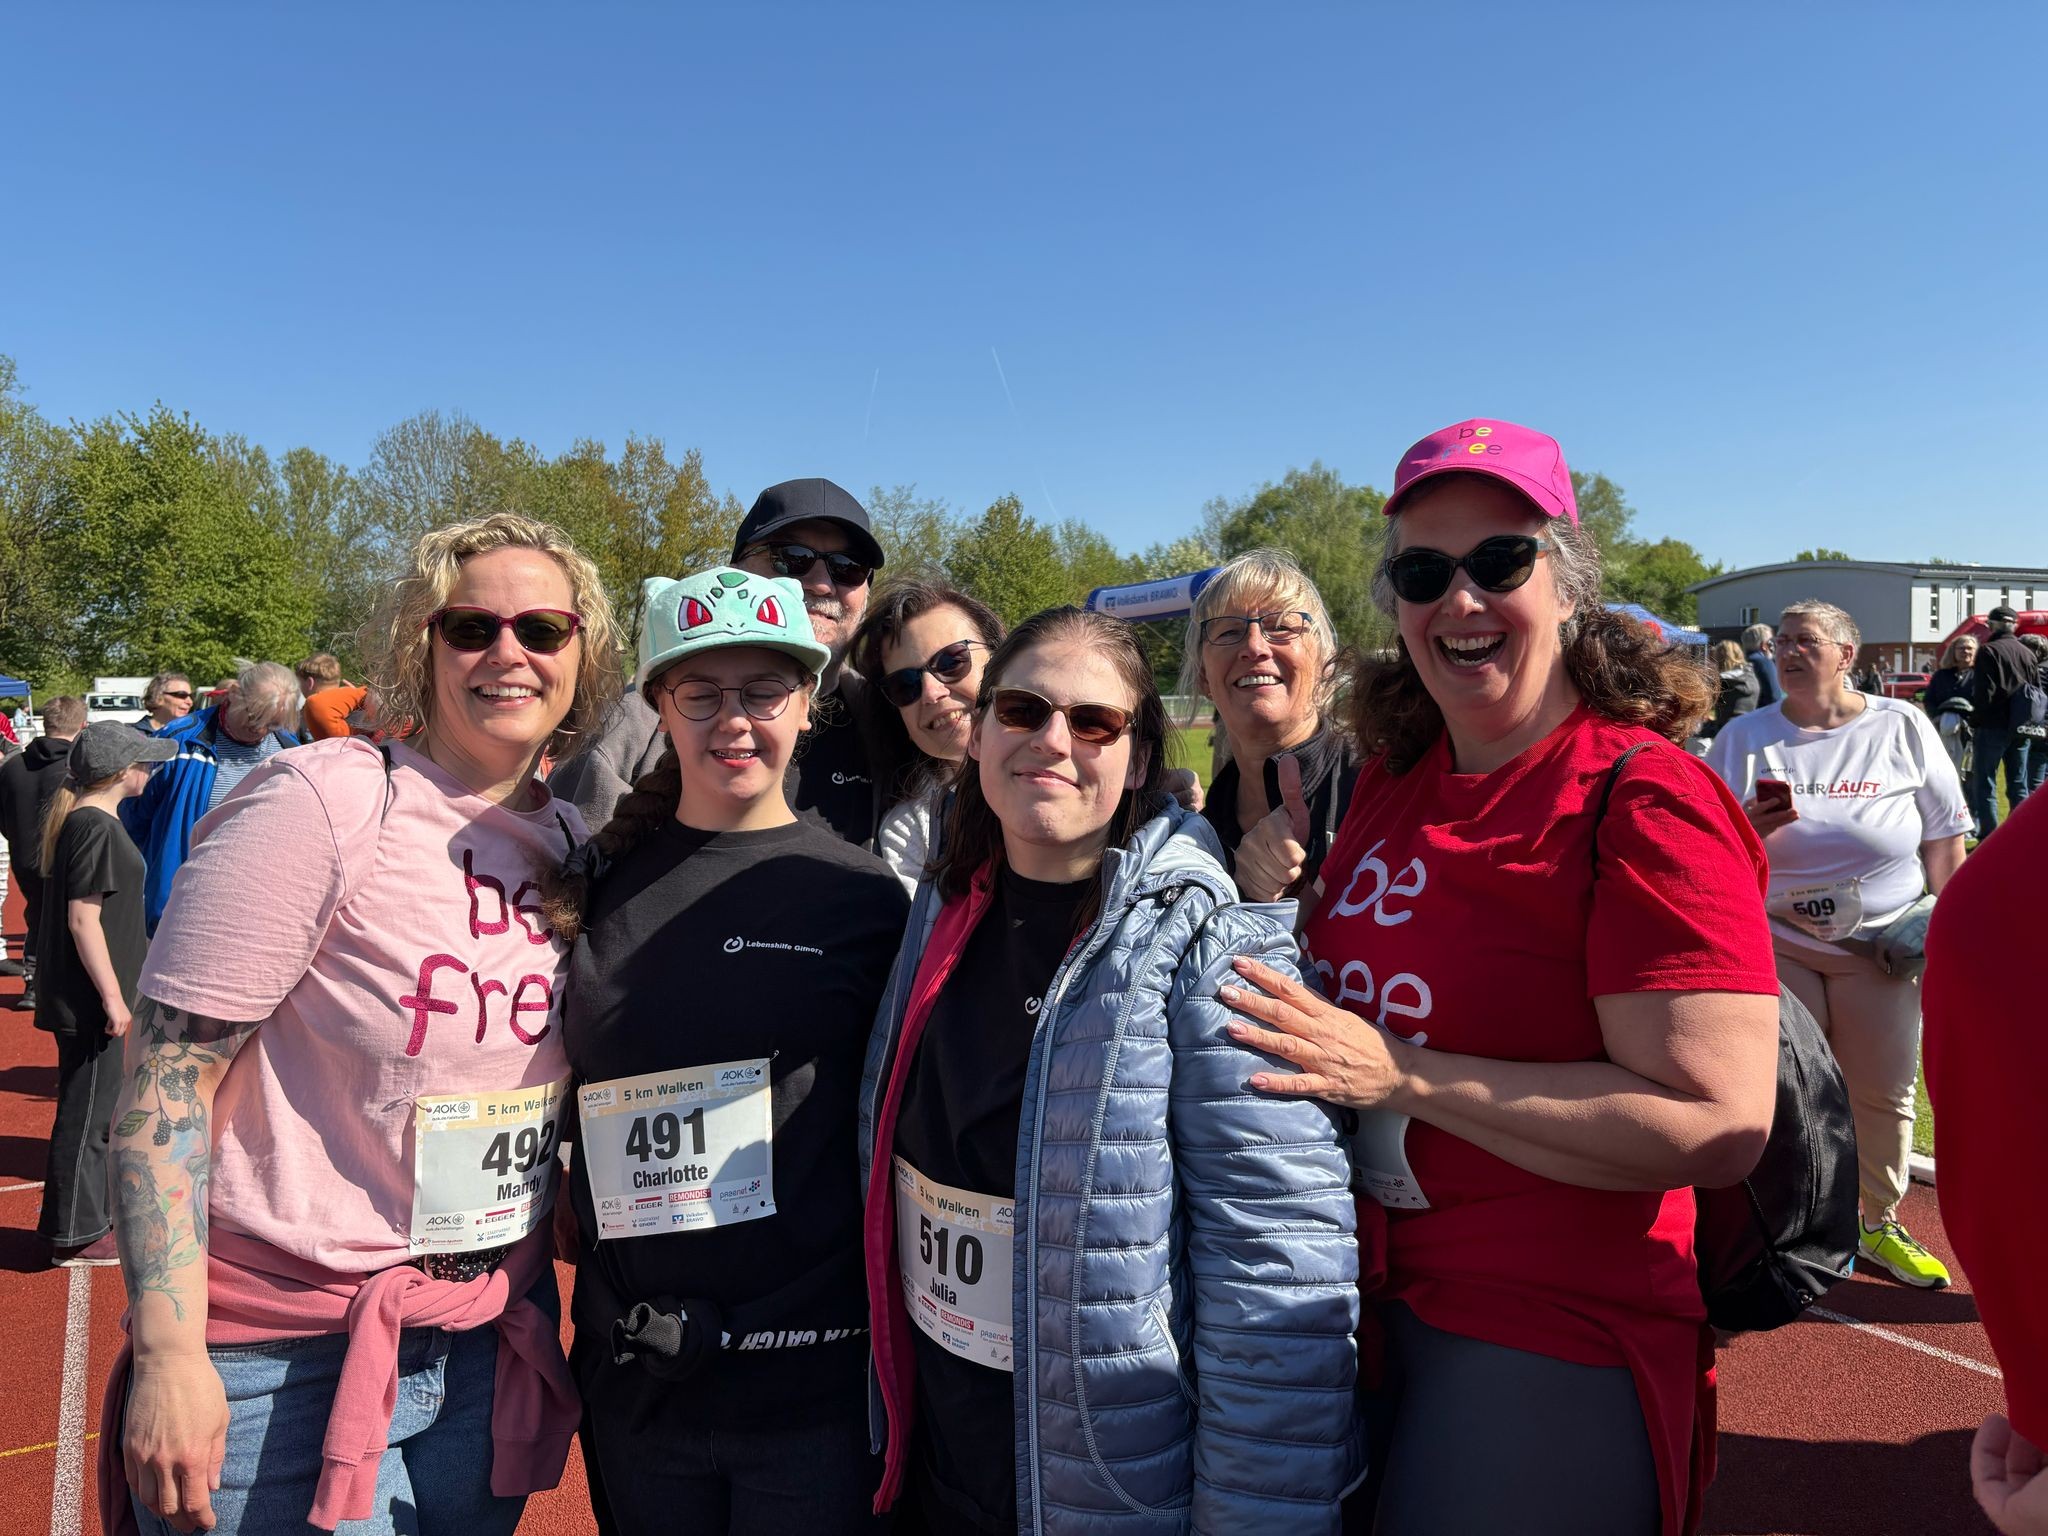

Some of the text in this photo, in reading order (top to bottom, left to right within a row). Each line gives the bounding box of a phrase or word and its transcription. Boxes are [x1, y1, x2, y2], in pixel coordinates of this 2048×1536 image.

[1459, 426, 1492, 439] be
[1328, 838, 1427, 926] be
[463, 848, 553, 945] be
[1792, 897, 1836, 918] 509
[746, 940, 792, 950] Lebenshilfe
[399, 953, 554, 1057] fre
[721, 1069, 744, 1081] AOK
[587, 1090, 603, 1102] AOK
[624, 1080, 704, 1101] 5 km Walken
[432, 1103, 457, 1114] AOK
[487, 1095, 558, 1116] 5 km Walken
[625, 1107, 706, 1163] 491
[481, 1120, 555, 1177] 492
[633, 1164, 709, 1189] Charlotte
[496, 1174, 542, 1201] Mandy
[669, 1189, 709, 1202] REMONDIS
[635, 1201, 663, 1210] EGGER
[920, 1185, 980, 1219] 5 km Walken
[997, 1206, 1015, 1218] AO
[426, 1215, 452, 1225] AOK
[484, 1212, 516, 1224] EGGER
[920, 1213, 984, 1286] 510
[929, 1276, 957, 1306] Julia
